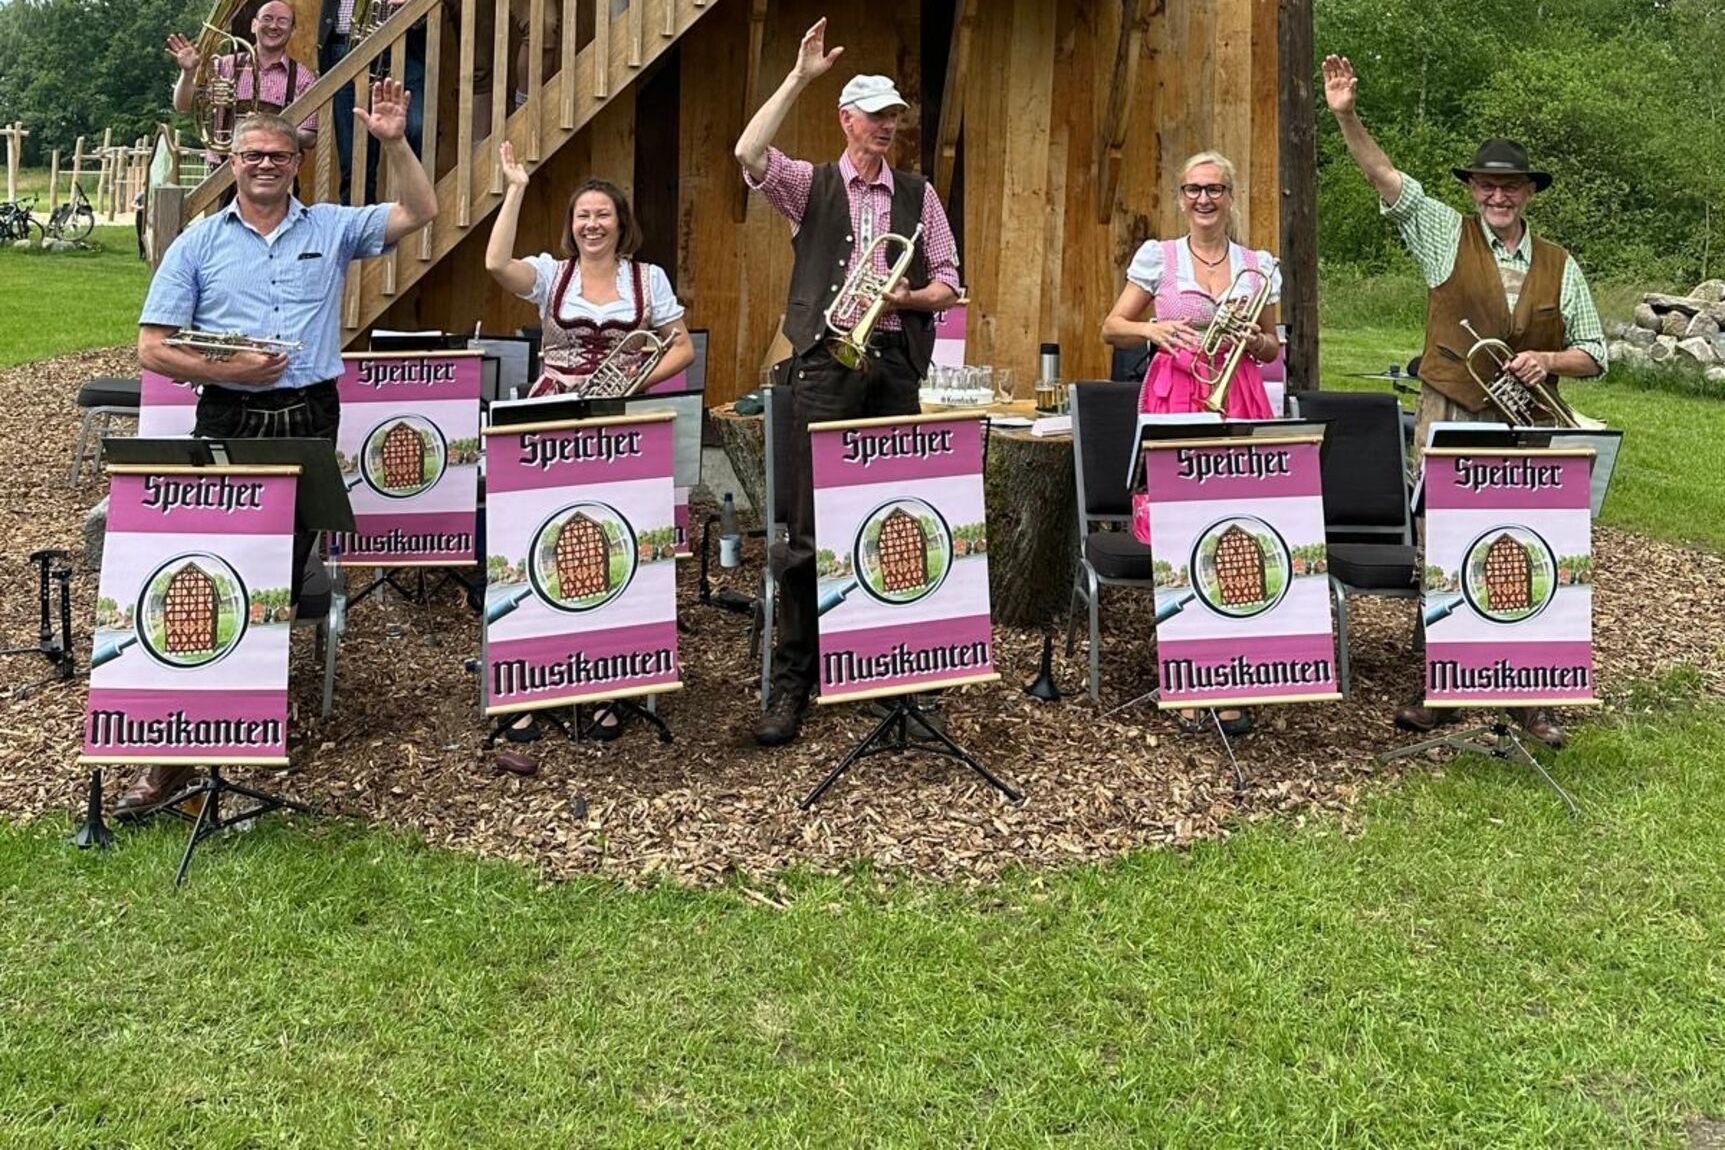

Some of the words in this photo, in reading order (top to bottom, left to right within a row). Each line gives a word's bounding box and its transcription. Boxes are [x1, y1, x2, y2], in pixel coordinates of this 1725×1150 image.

[357, 360, 455, 388] Speicher
[519, 428, 641, 470] Speicher
[842, 426, 953, 466] Speicher
[1178, 449, 1290, 482] Speicher
[1454, 457, 1562, 491] Speicher
[142, 476, 264, 513] Speicher
[333, 529, 473, 555] Musikanten
[493, 648, 673, 696] Musikanten
[824, 641, 990, 687] Musikanten
[1163, 656, 1331, 693] Musikanten
[1430, 659, 1588, 692] Musikanten
[92, 711, 282, 747] Musikanten
